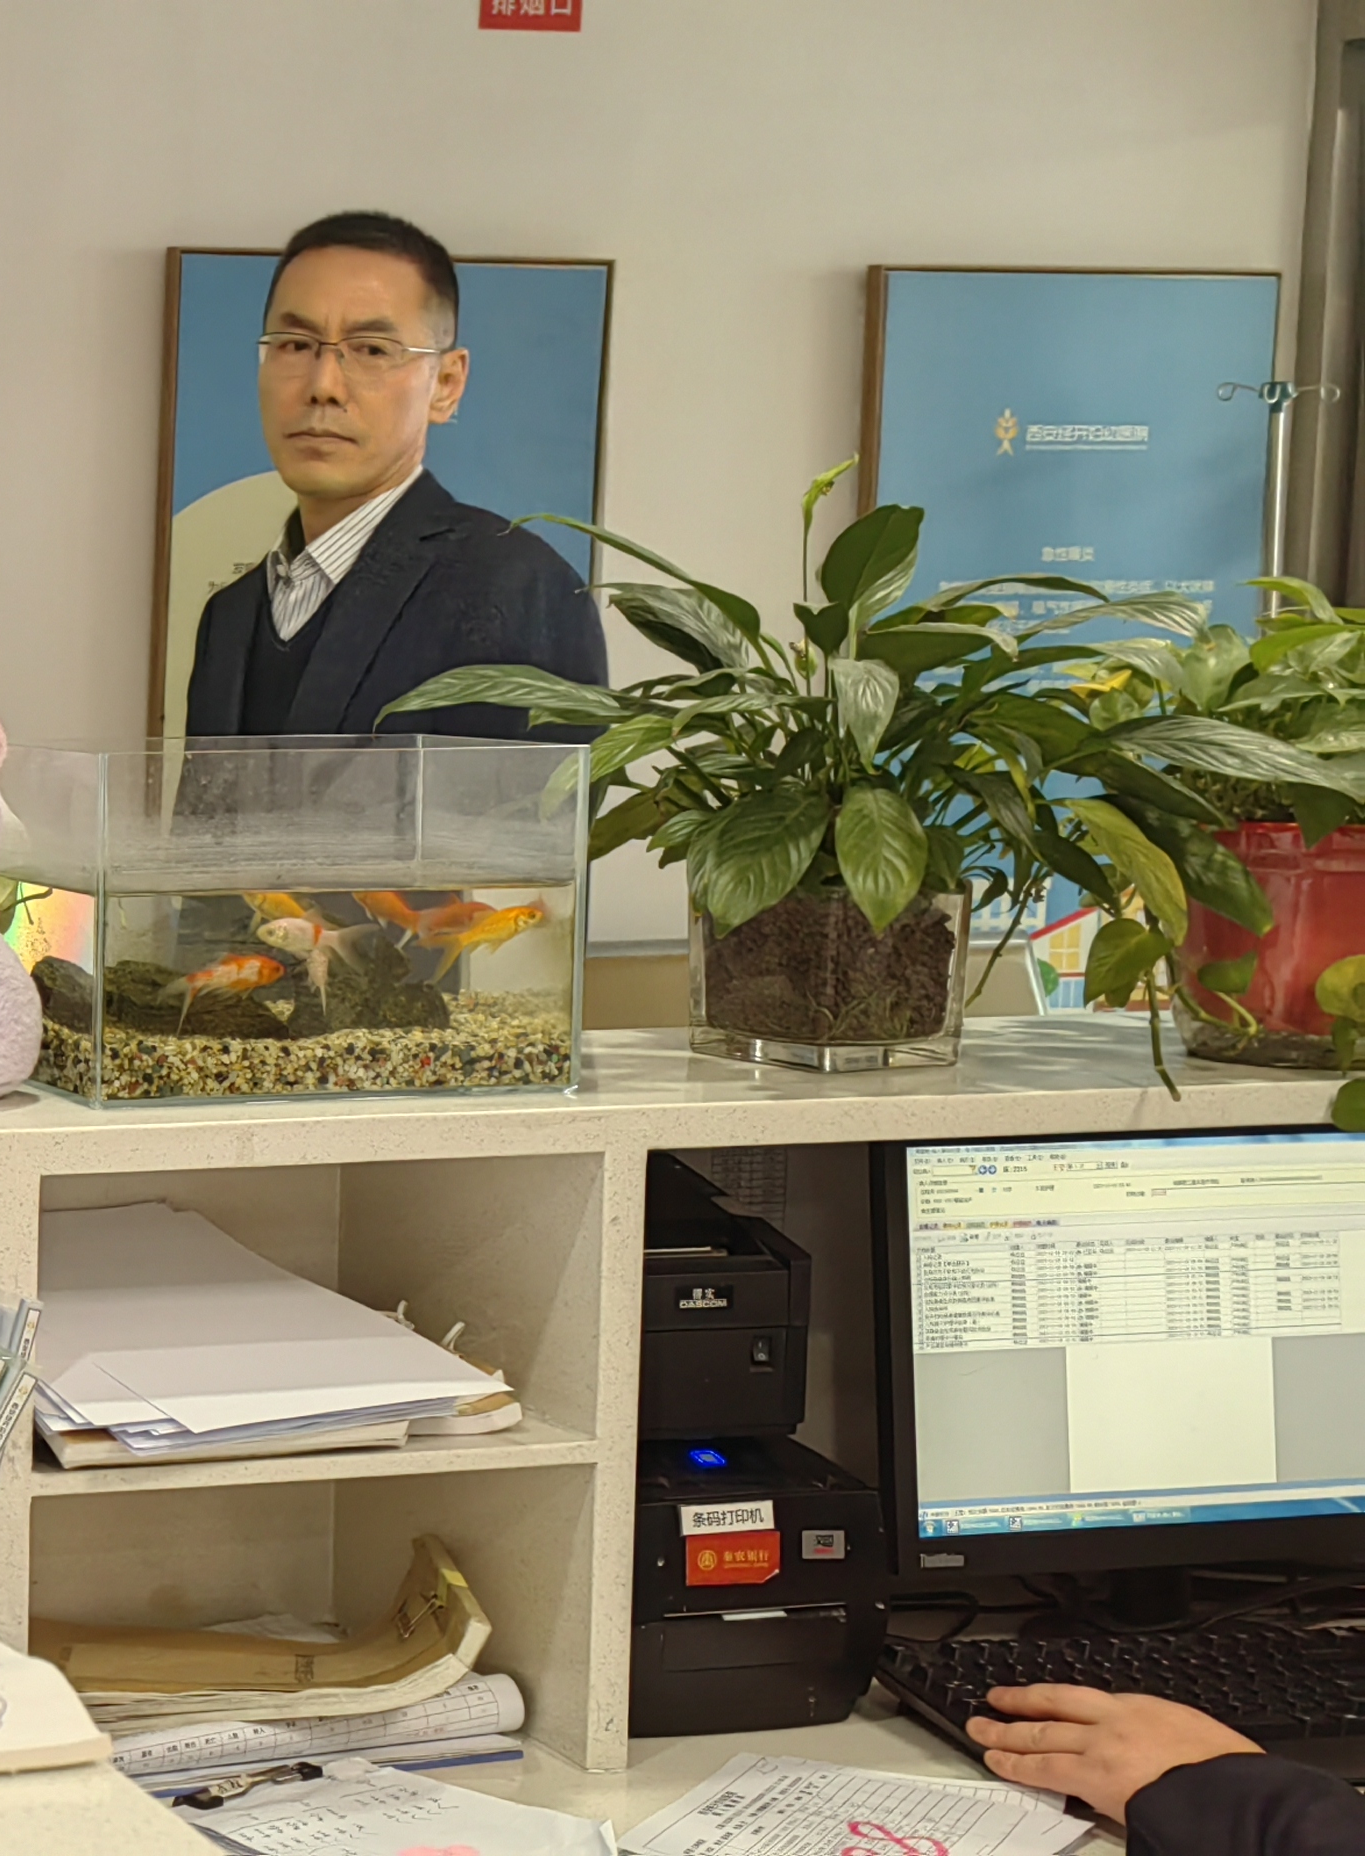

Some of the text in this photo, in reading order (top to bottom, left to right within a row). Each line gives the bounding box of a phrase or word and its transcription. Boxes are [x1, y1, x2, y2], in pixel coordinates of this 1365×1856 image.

[693, 1508, 764, 1528] 条码打印机
